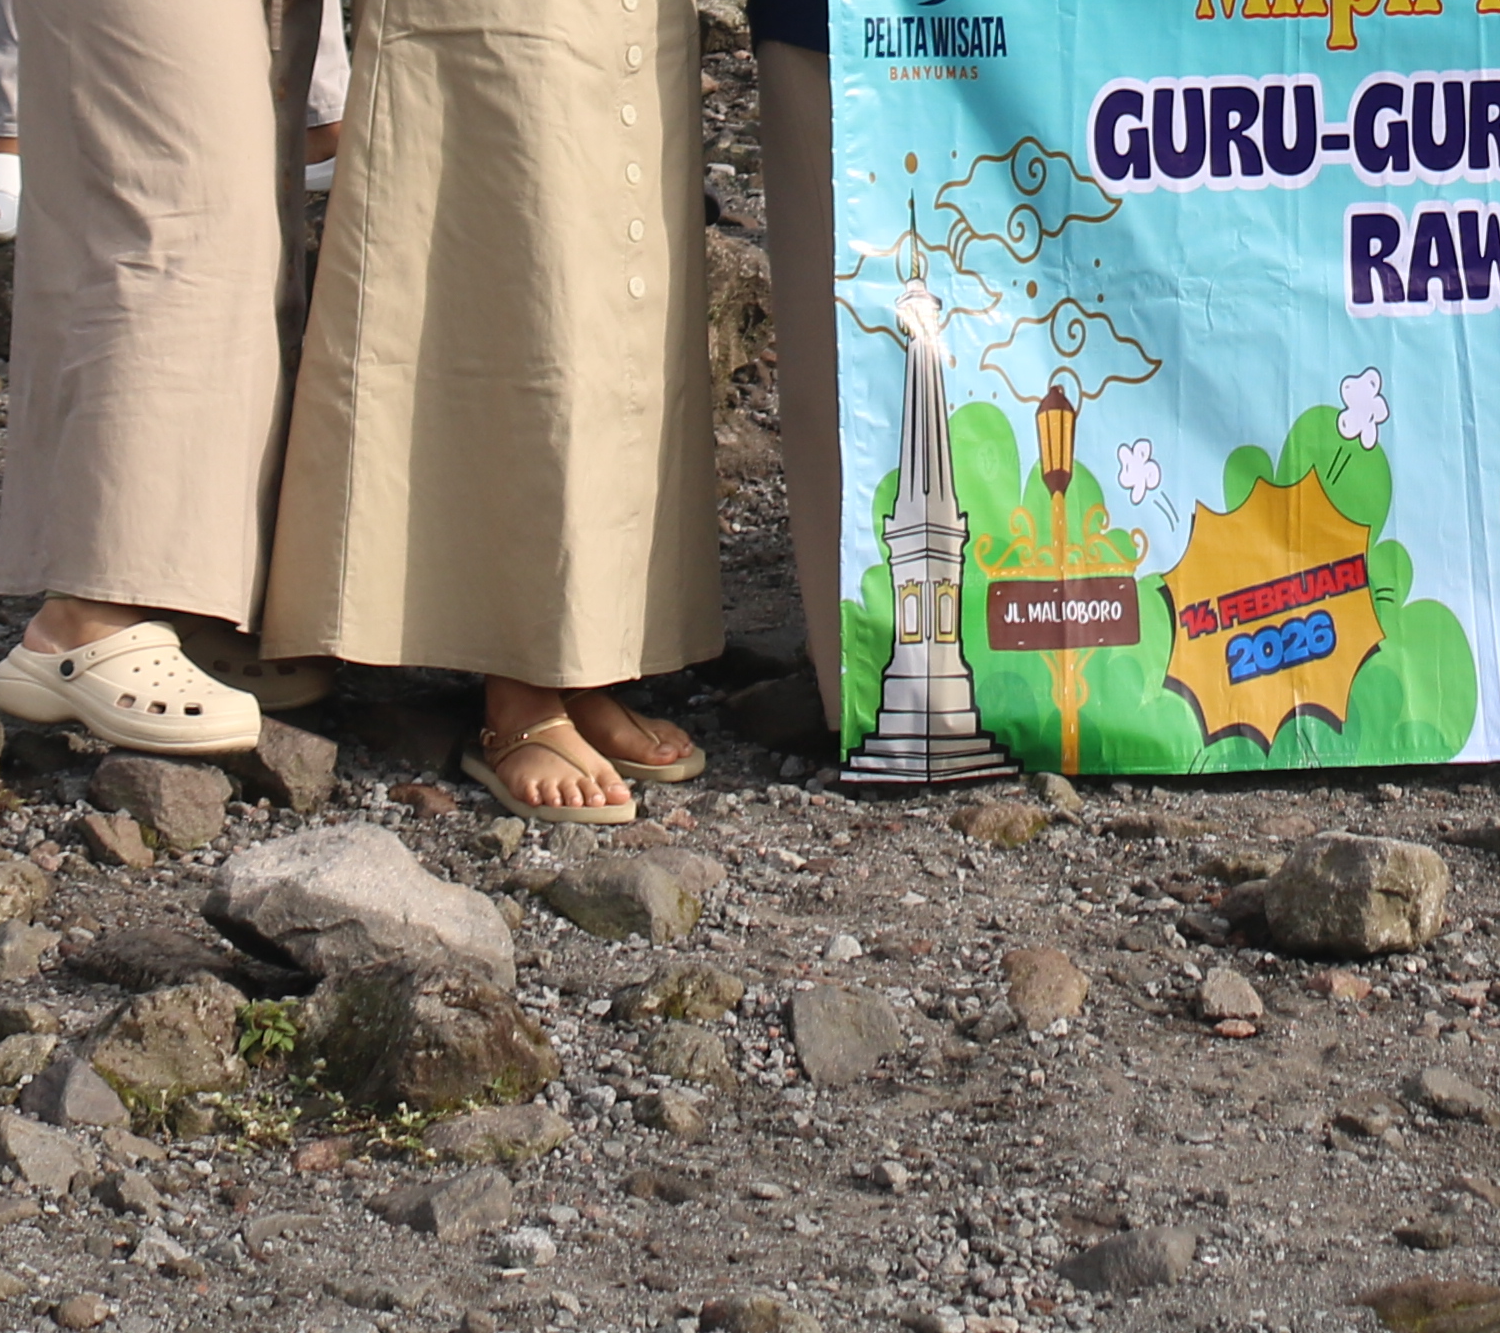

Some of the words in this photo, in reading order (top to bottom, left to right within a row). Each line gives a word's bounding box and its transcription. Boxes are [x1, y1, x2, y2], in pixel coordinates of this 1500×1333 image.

[864, 16, 928, 58] PELITA
[931, 16, 1007, 58] WISATA
[890, 66, 979, 81] BANYUMAS
[1004, 602, 1026, 625] JL.
[1028, 600, 1122, 624] MALIOBORO
[1180, 599, 1218, 640] 14
[1217, 554, 1369, 630] FEBRUARI
[1225, 609, 1336, 685] 2026
